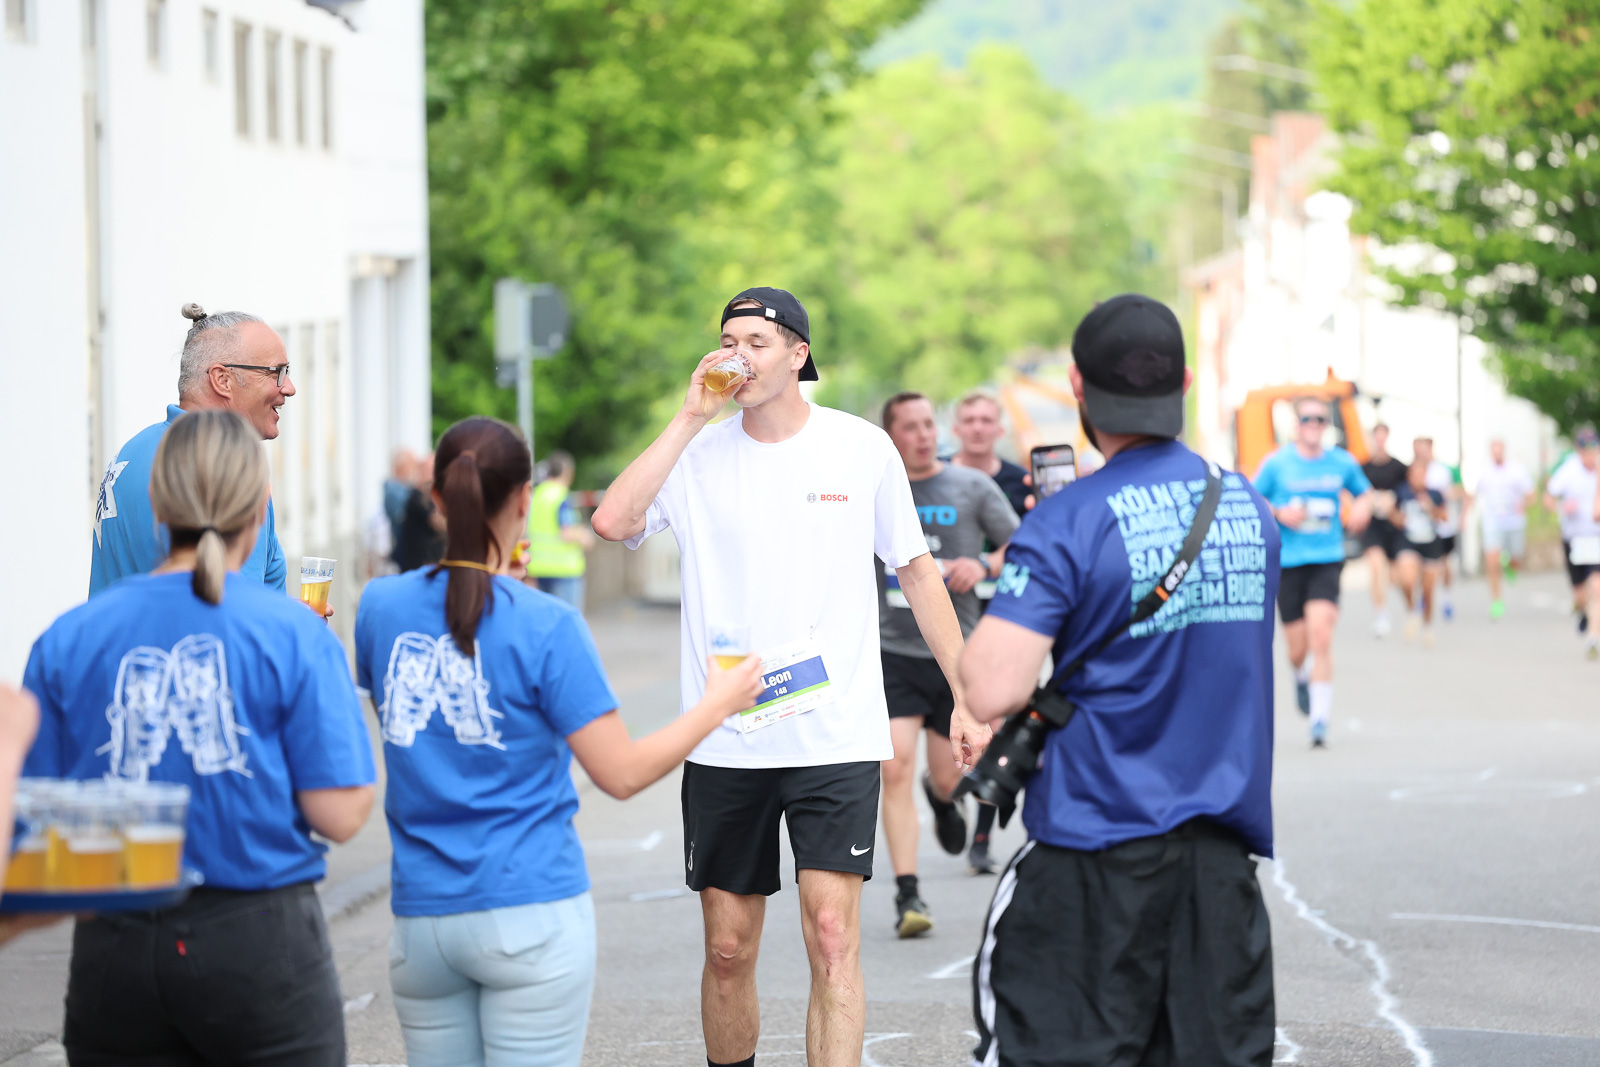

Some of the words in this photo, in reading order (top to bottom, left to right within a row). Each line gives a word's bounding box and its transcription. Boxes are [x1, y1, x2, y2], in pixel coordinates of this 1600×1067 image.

[820, 494, 848, 502] BOSCH
[1107, 484, 1174, 519] KÖLN
[1203, 518, 1265, 547] MAINZ
[1223, 546, 1266, 572] LUXEM
[1226, 572, 1266, 604] BURG
[761, 670, 792, 689] Leon
[774, 687, 788, 697] 148
